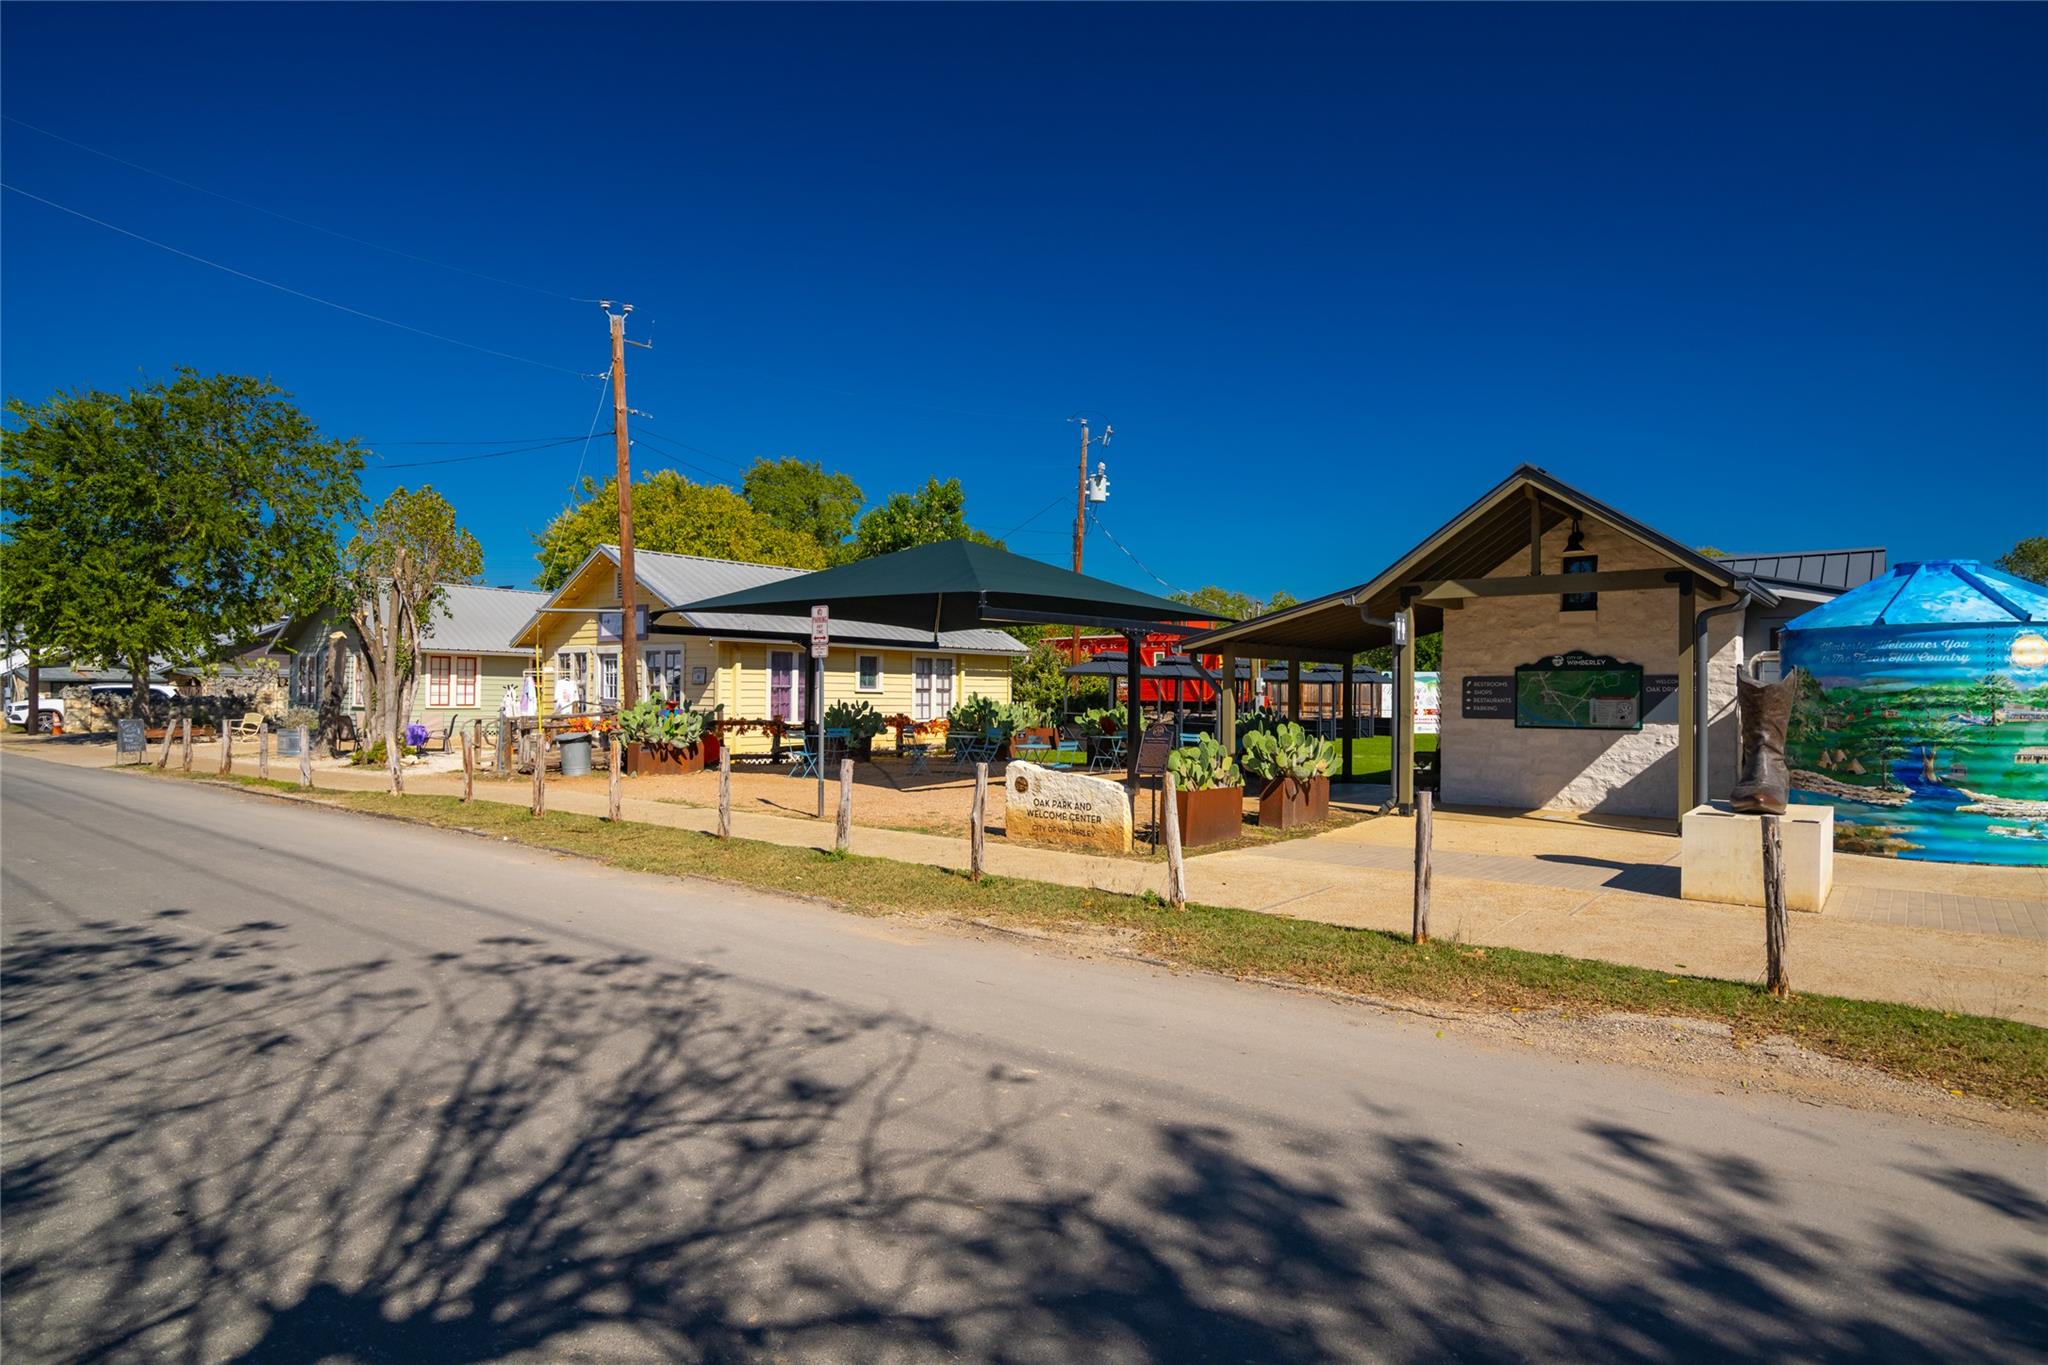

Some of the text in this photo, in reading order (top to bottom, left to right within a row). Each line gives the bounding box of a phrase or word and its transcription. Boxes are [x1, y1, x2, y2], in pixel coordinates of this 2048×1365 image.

[1874, 639, 1937, 650] Welcomes
[1941, 639, 1970, 651] You
[1832, 653, 1852, 664] The
[1853, 652, 1886, 663] Texas
[1888, 652, 1915, 664] Hill
[1917, 652, 1971, 664] Country
[1033, 798, 1092, 812] OAK PARK AND
[1027, 809, 1102, 824] WELCOME CENTER
[1032, 824, 1096, 837] CITY OF WIMBERLEY
